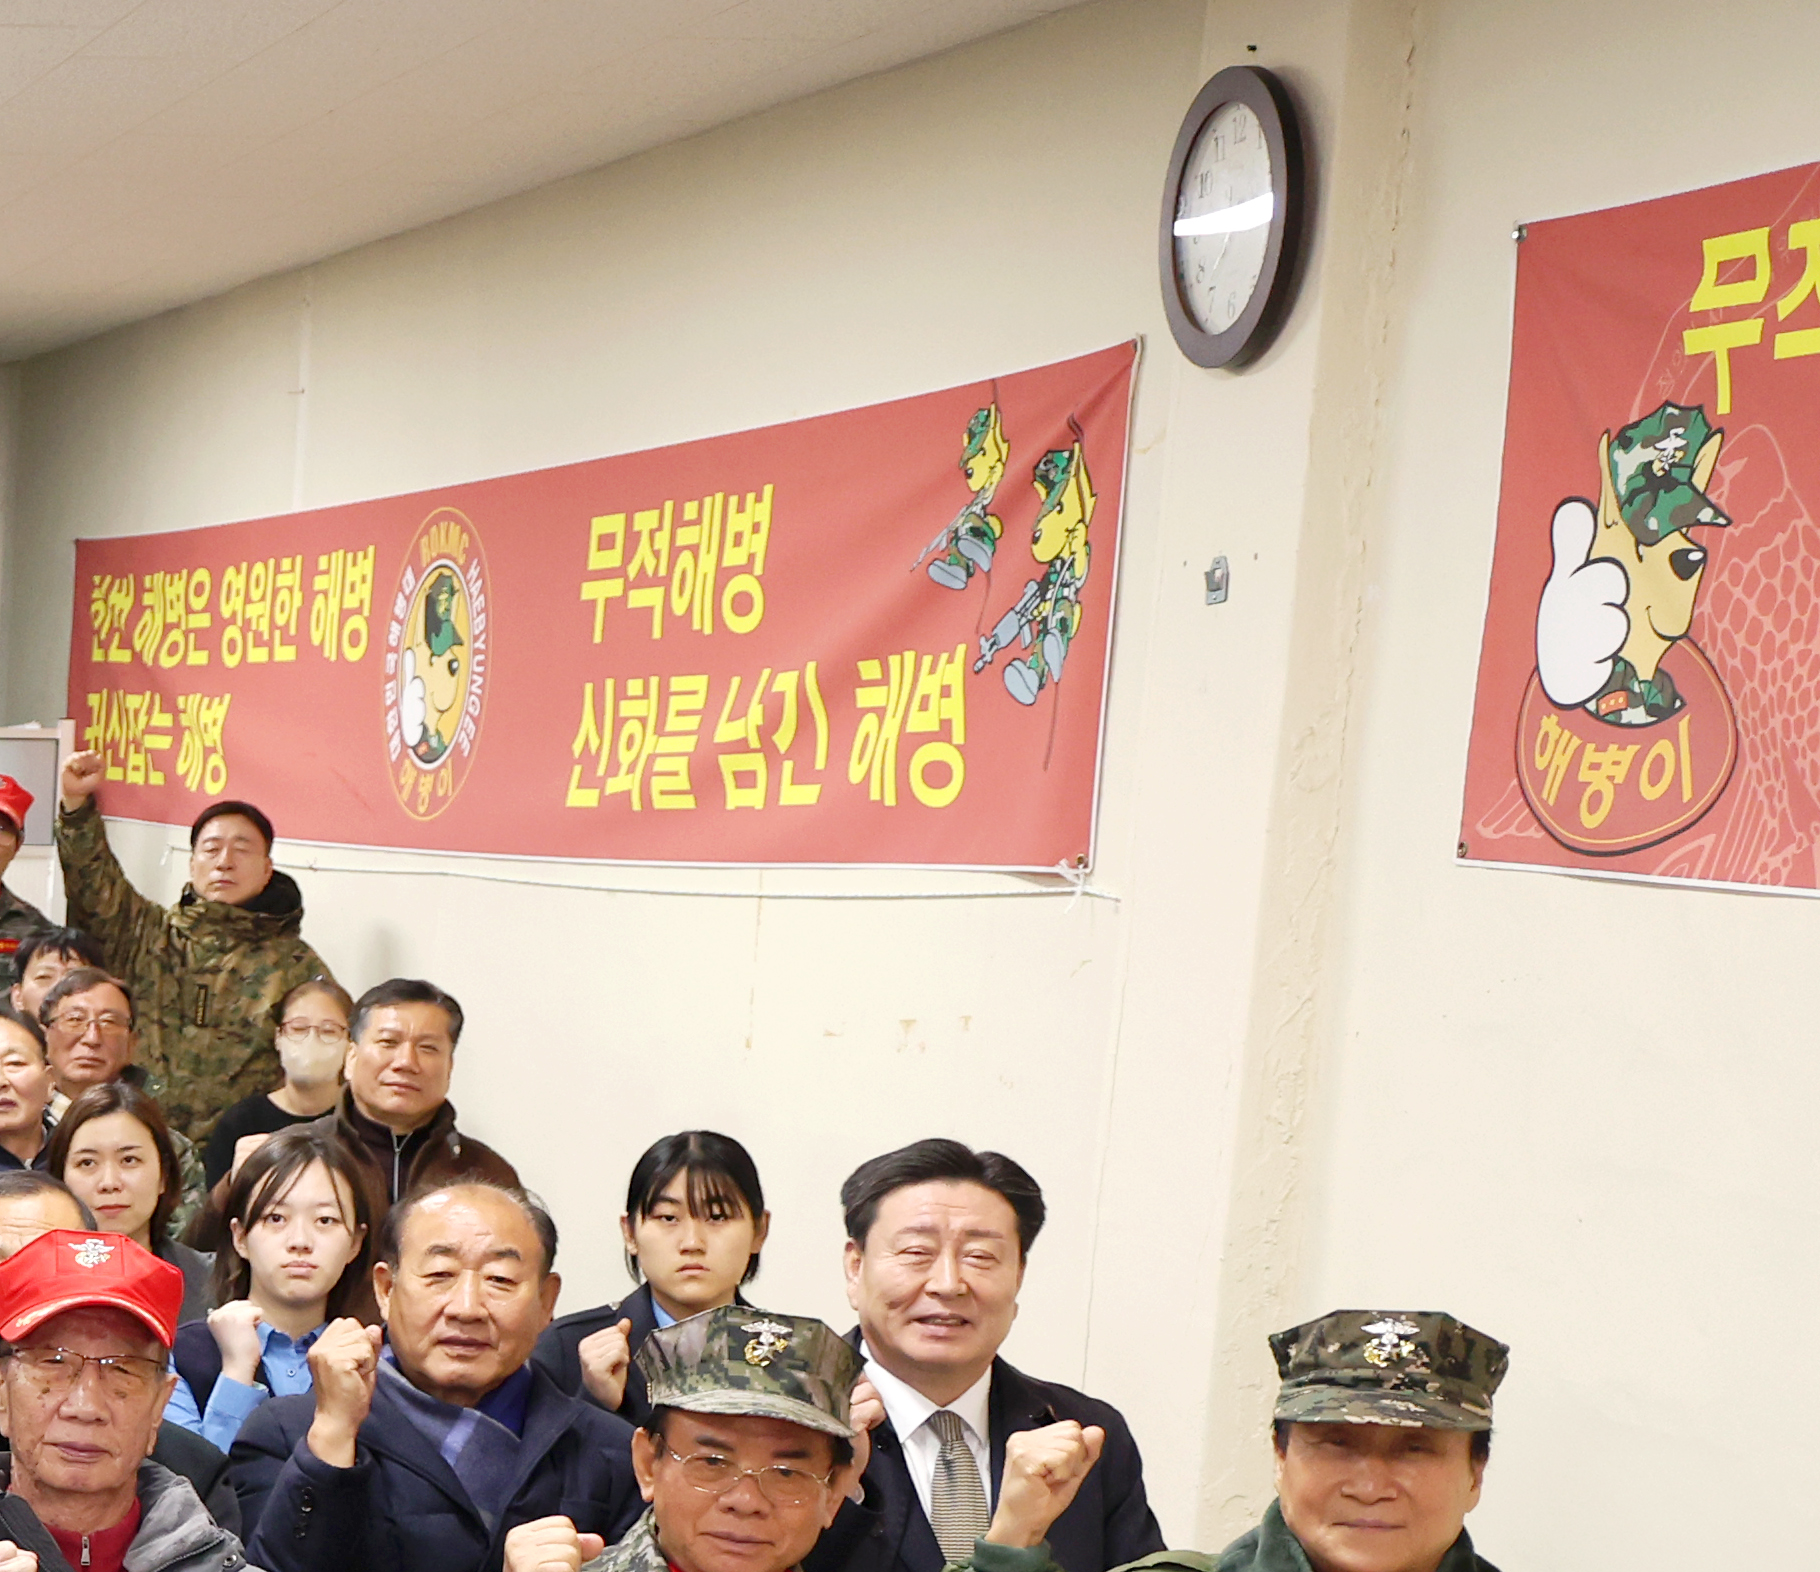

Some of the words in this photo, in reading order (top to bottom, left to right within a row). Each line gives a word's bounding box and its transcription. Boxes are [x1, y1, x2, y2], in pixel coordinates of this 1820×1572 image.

[132, 566, 213, 669] 해병은
[219, 554, 304, 669] 영원한
[309, 544, 377, 663] 해병
[579, 483, 775, 645] 무적해병
[175, 692, 232, 796] 해병
[564, 673, 710, 812] 신화를
[712, 660, 829, 811] 남긴
[847, 643, 968, 809] 해병
[1534, 713, 1694, 830] 해병이
